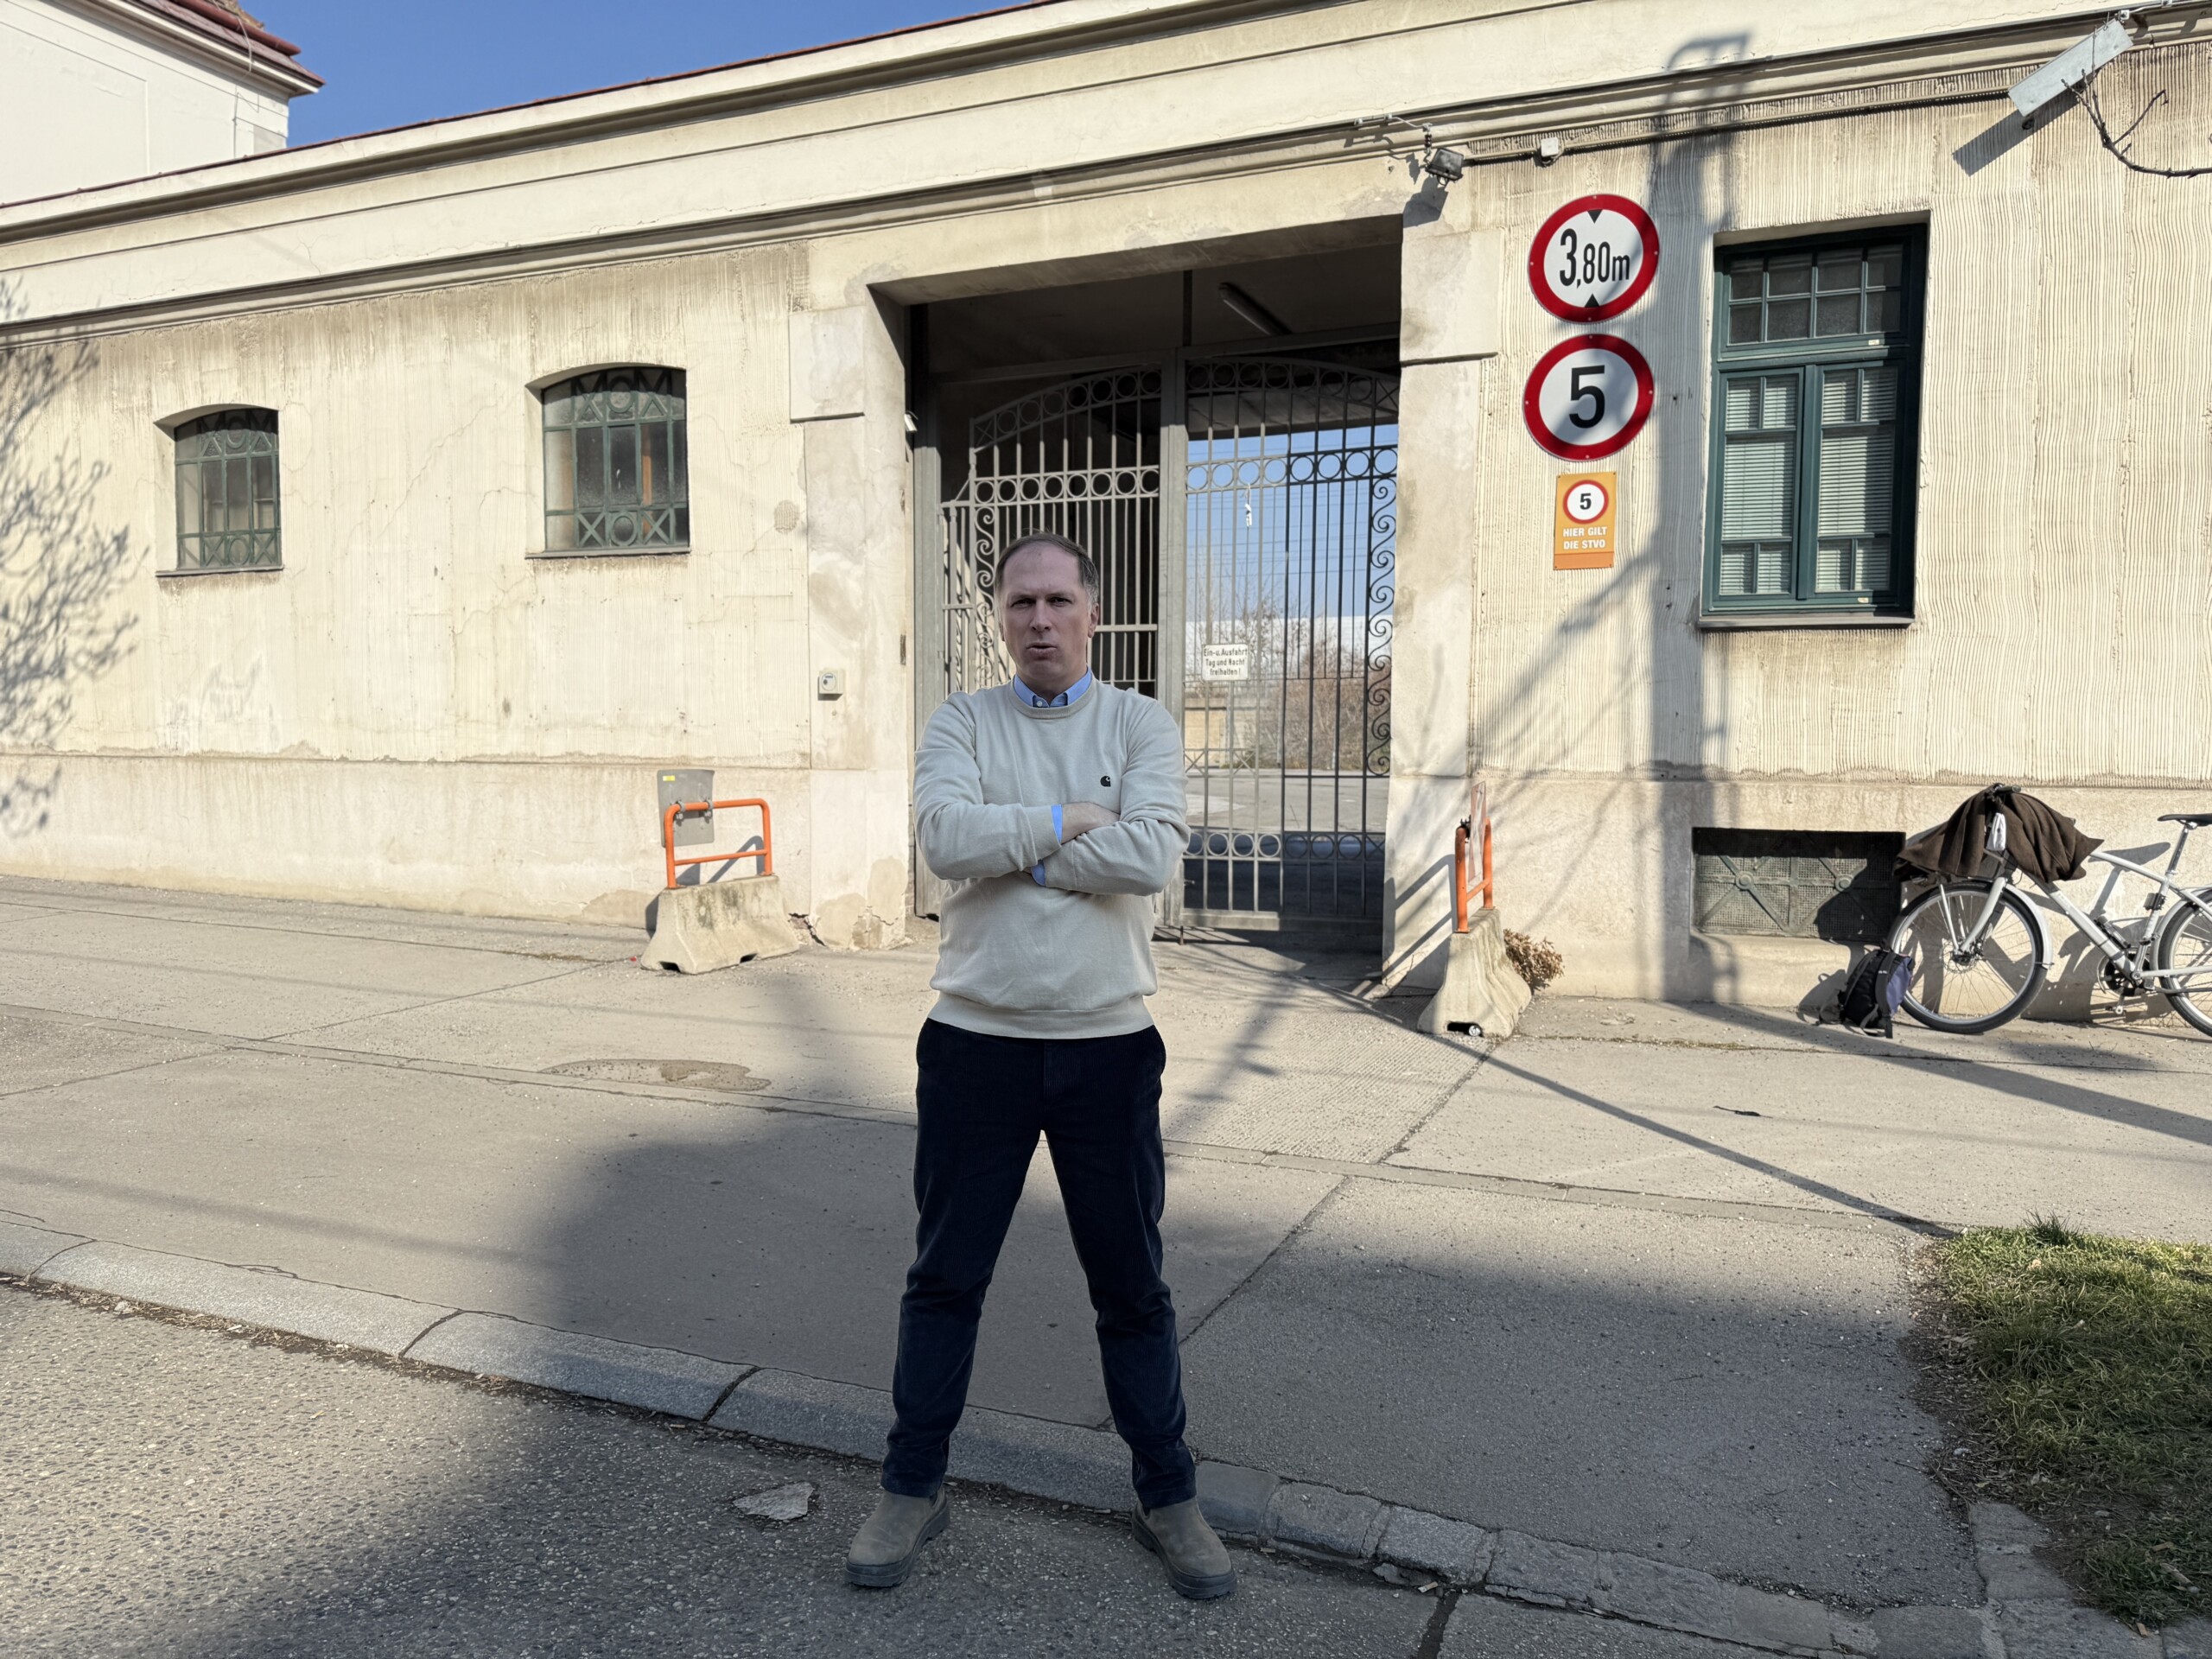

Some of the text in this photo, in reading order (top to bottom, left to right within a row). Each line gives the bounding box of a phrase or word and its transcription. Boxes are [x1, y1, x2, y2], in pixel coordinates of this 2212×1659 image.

[1569, 365, 1605, 429] 5
[1580, 493, 1592, 510] 5
[1563, 526, 1607, 537] HIER GILT
[1563, 539, 1605, 550] DIE STVO
[1205, 658, 1215, 668] Tag
